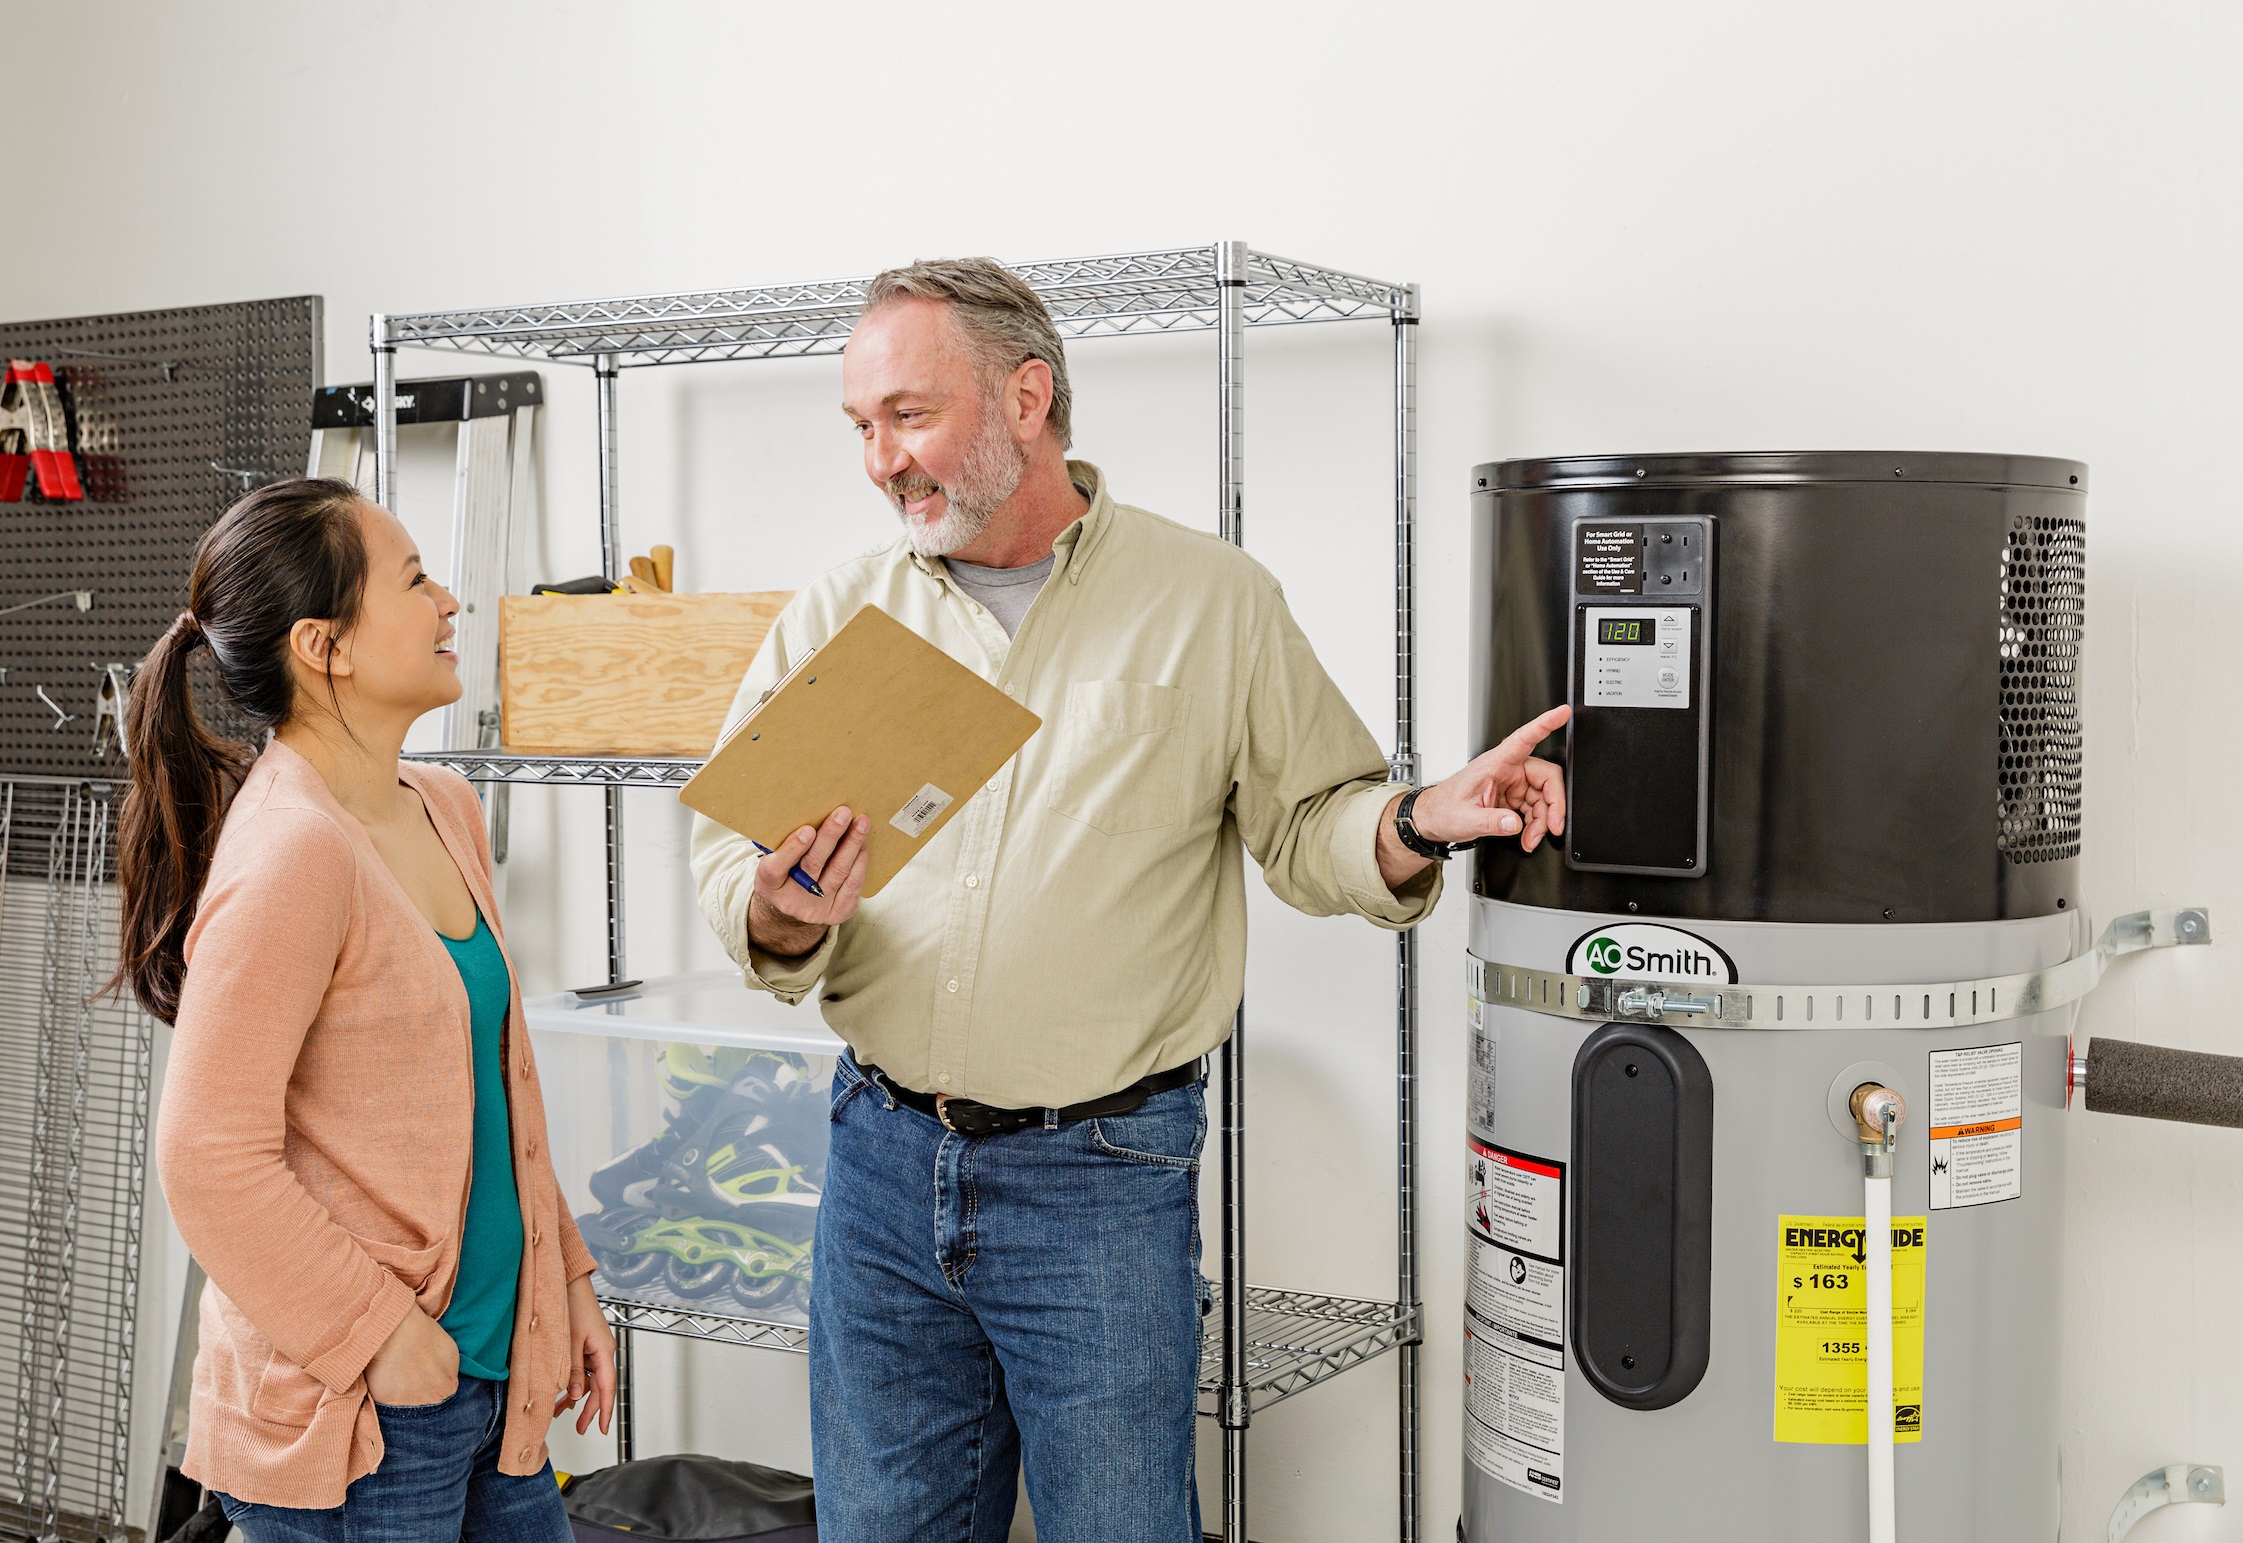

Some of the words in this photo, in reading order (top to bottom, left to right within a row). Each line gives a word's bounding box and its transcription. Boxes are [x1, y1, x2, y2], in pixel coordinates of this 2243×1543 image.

[1613, 530, 1626, 538] Grid
[1607, 545, 1622, 553] Only
[1606, 622, 1641, 641] 120
[1964, 1125, 1995, 1135] WARNING
[1487, 1150, 1509, 1165] DANGER
[1813, 1263, 1841, 1271] Estimated
[1842, 1264, 1860, 1272] Yearly
[1793, 1276, 1803, 1290] $
[1809, 1273, 1849, 1290] 163
[1821, 1342, 1861, 1354] 1355
[1820, 1386, 1843, 1394] depend
